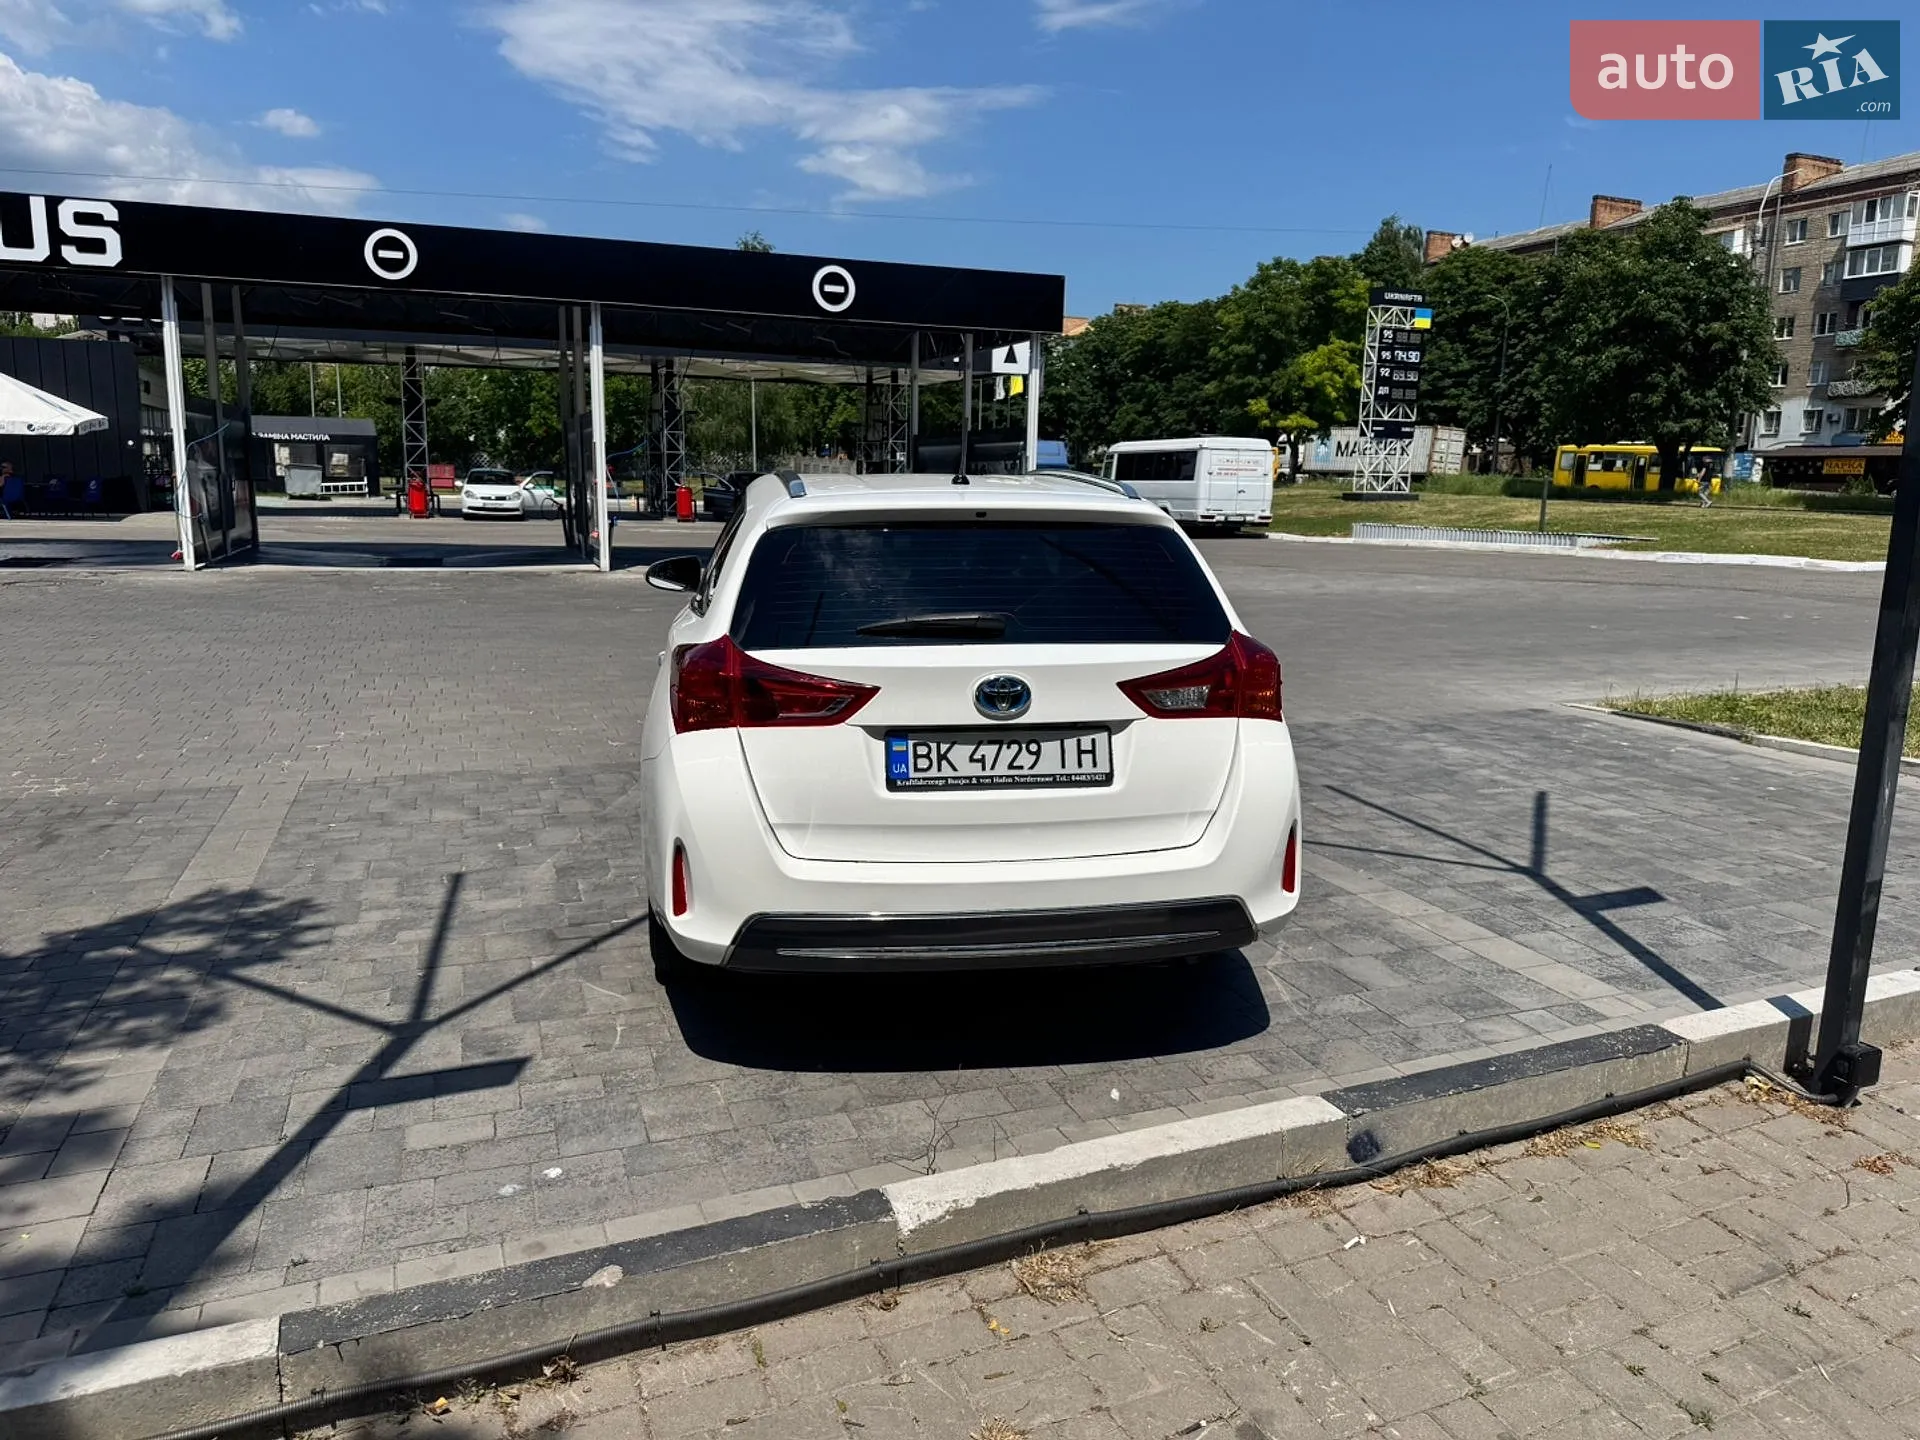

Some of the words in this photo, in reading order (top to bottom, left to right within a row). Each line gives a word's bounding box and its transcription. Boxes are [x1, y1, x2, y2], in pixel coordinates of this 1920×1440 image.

[1381, 350, 1391, 360] 95
[1380, 367, 1390, 377] 92
[291, 433, 330, 441] МАСТИЛА
[911, 741, 958, 773] BK
[969, 739, 1043, 772] 4729
[1060, 737, 1098, 769] IH
[892, 763, 908, 774] UA
